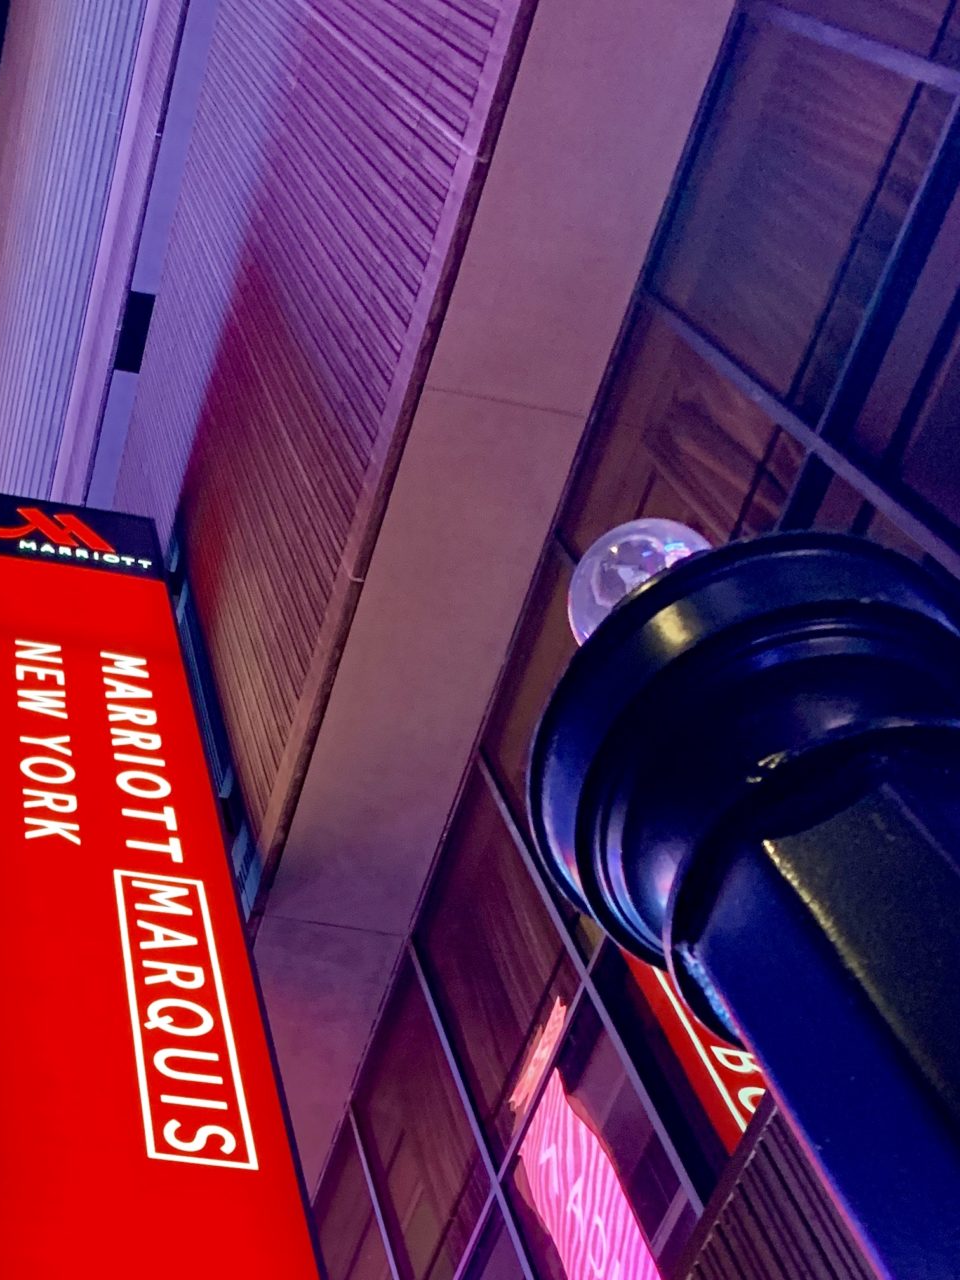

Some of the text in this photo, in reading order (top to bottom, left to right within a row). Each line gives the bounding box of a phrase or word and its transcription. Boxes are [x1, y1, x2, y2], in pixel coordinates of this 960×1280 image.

[17, 539, 154, 570] MARRIOTT
[14, 639, 82, 847] NEW YORK
[99, 651, 238, 1156] MARRIOTT MARQUIS
